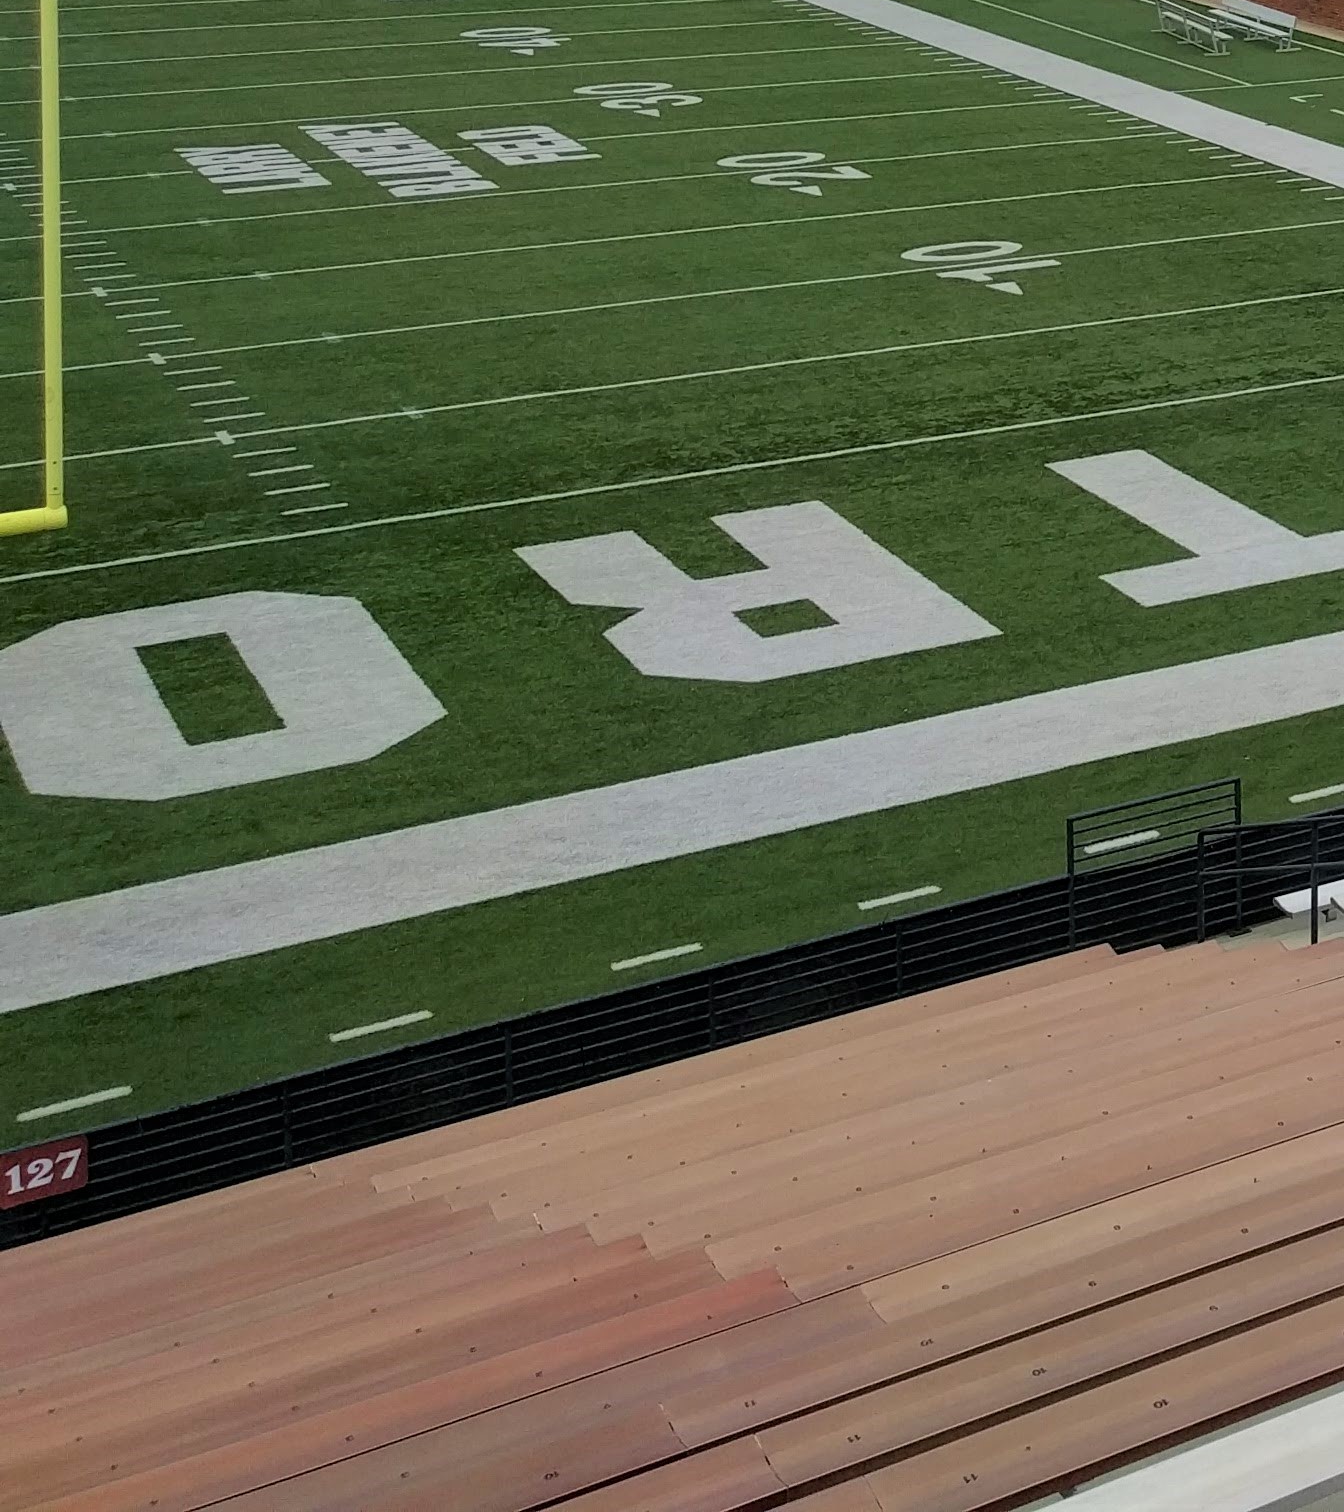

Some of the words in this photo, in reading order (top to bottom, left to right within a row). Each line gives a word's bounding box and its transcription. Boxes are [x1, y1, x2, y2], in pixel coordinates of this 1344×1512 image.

[459, 26, 572, 48] 40
[573, 81, 703, 109] 30
[299, 121, 500, 197] BLAKENEY
[457, 125, 602, 166] FIELD
[173, 143, 332, 194] LARRY
[716, 151, 872, 186] 20
[900, 240, 1062, 283] 10
[4, 1148, 82, 1195] 127
